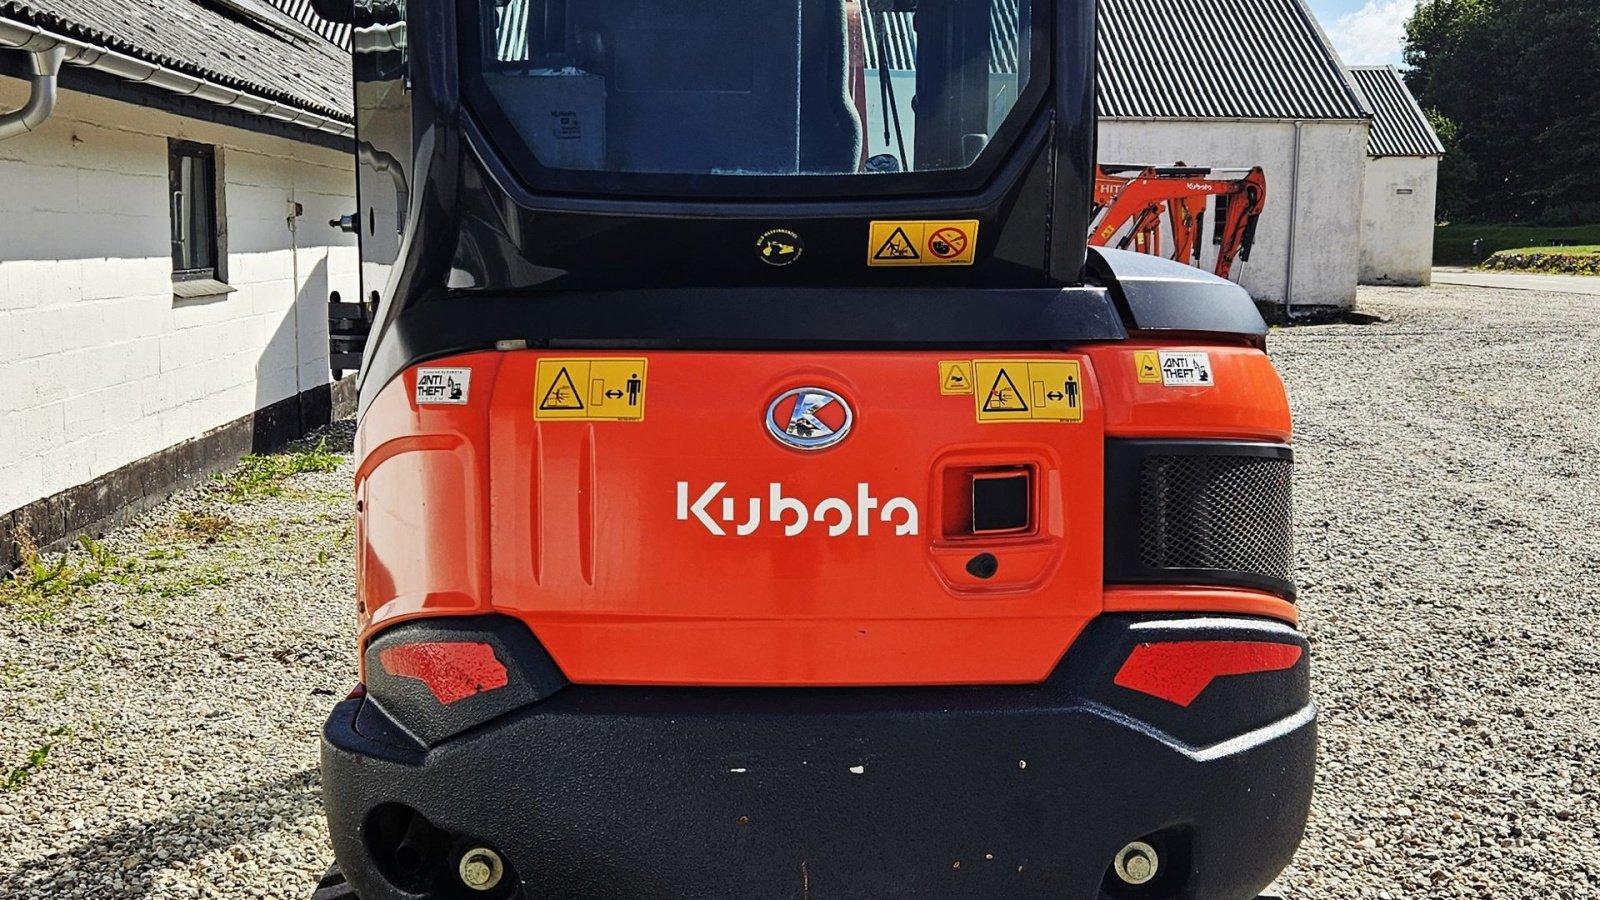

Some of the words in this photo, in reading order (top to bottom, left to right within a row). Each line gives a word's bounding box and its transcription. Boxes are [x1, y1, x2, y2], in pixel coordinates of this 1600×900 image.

[1100, 184, 1121, 194] HIT
[1163, 357, 1189, 368] ANTI
[1163, 368, 1194, 379] THEFT
[418, 375, 442, 385] ANTI
[417, 386, 446, 396] THEFT
[676, 481, 919, 537] Kubota
